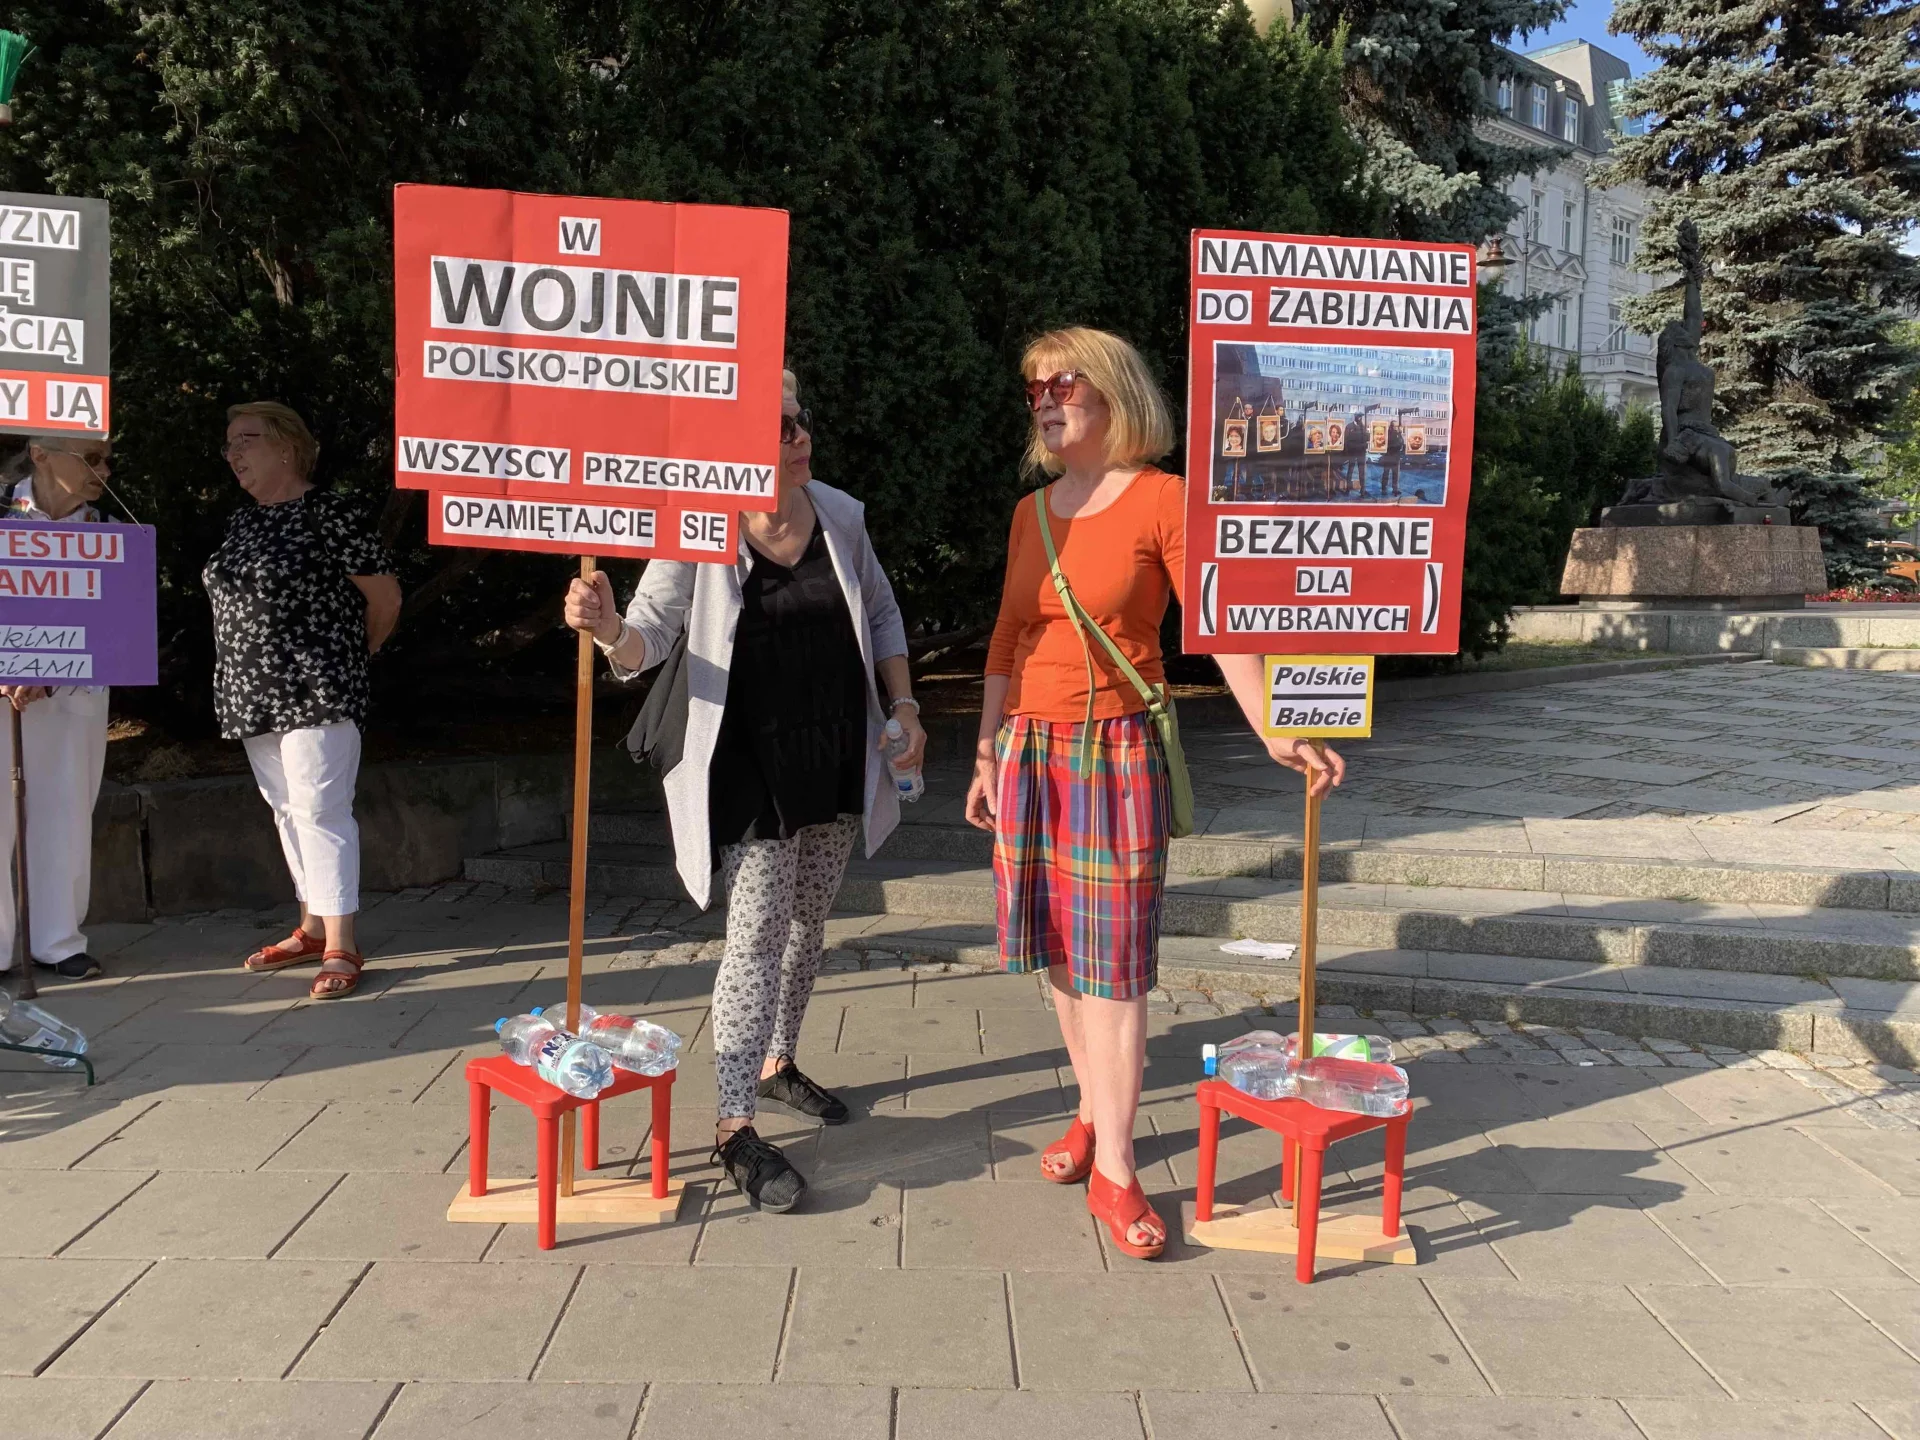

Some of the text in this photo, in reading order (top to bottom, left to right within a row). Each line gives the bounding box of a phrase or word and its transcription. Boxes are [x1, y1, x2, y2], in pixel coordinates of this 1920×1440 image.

[561, 221, 598, 251] W
[1202, 238, 1469, 285] NAMAWIANIE
[433, 259, 738, 343] WOJNIE
[1200, 289, 1470, 331] DO ZABIJANIA
[427, 344, 735, 396] POLSKO-POLSKIEJ
[50, 384, 99, 428] JĄ
[403, 439, 773, 492] WSZYSCY PRZEGRAMY
[444, 500, 726, 548] OPAMIĘTAJCIE SIĘ
[1219, 519, 1431, 556] BEZKARNE
[0, 530, 118, 560] ESTUJ
[1297, 569, 1350, 594] DLA
[1228, 606, 1410, 632] WYBRANYCH
[1274, 666, 1367, 688] Polskie
[1275, 707, 1362, 727] Babcie
